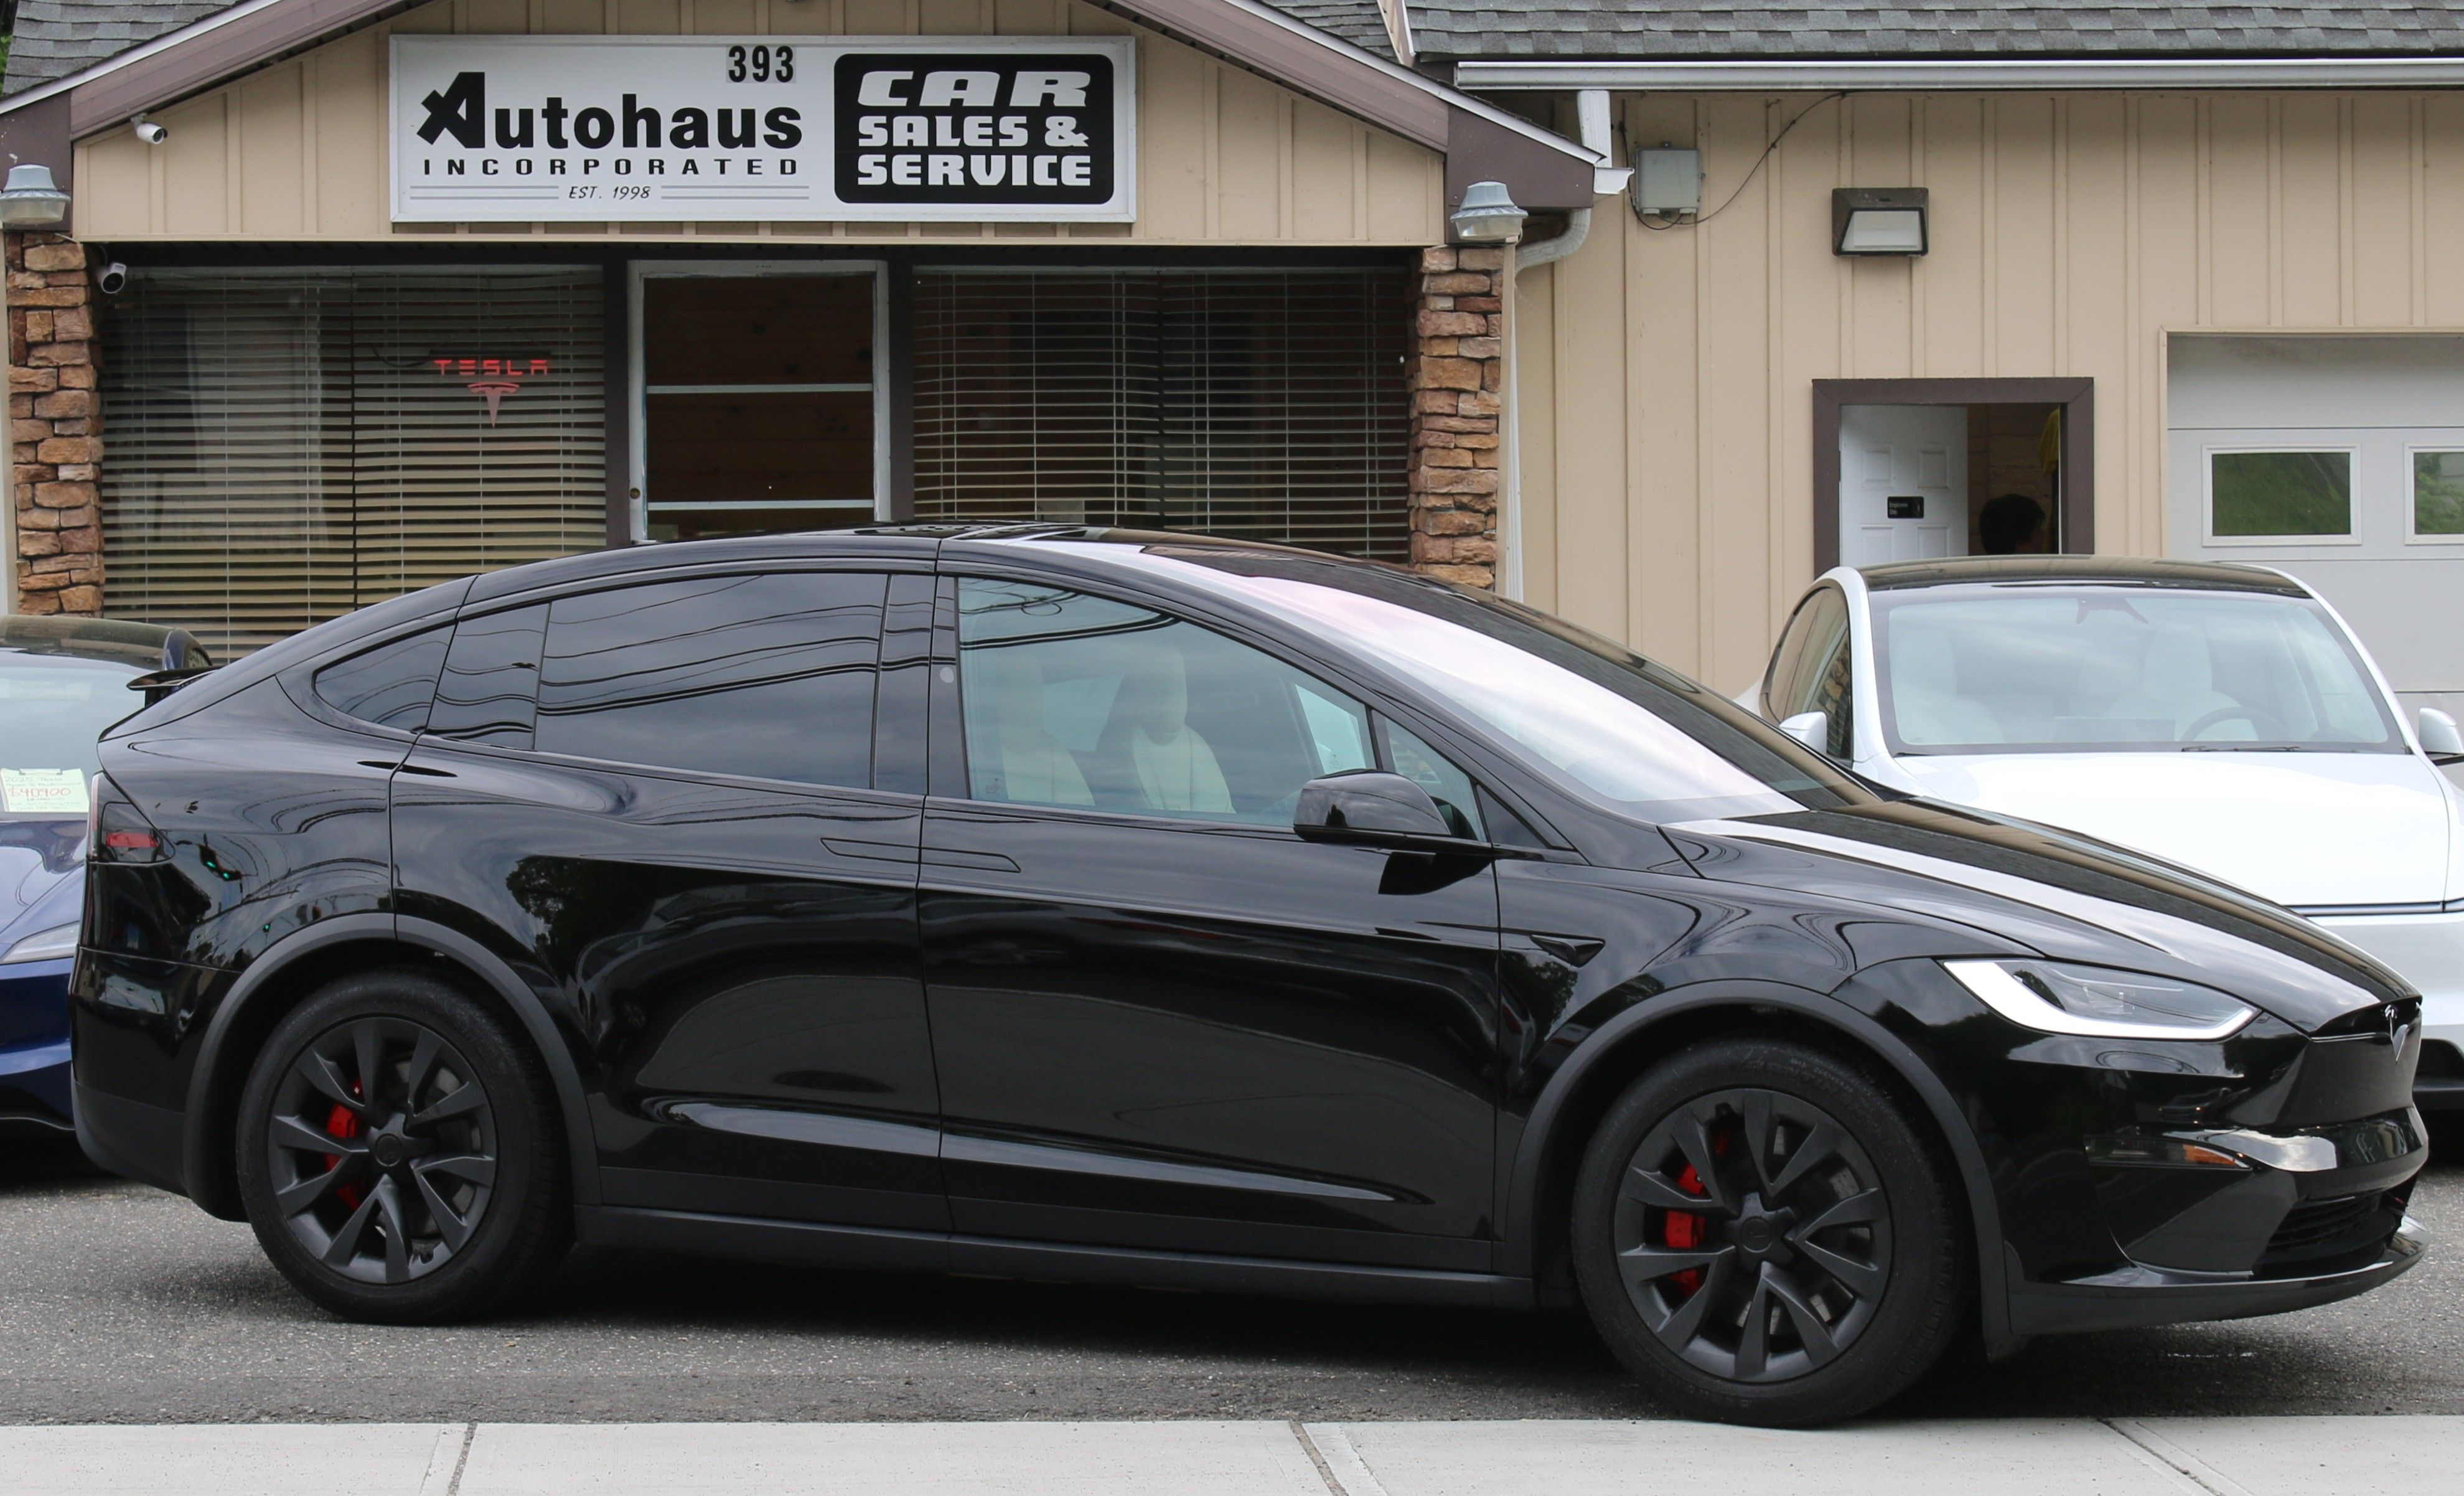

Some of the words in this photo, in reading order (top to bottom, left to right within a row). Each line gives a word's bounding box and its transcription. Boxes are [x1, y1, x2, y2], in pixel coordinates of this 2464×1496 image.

[728, 44, 794, 83] 393
[857, 70, 1091, 107] CAR
[416, 71, 803, 150] Autohaus
[858, 115, 1029, 148] SALES
[1044, 115, 1090, 148] &
[424, 158, 797, 176] INCORPORATED
[857, 154, 1091, 187] SERVICE
[568, 186, 602, 199] EST.
[613, 186, 651, 200] 1998
[434, 359, 548, 375] TESLA
